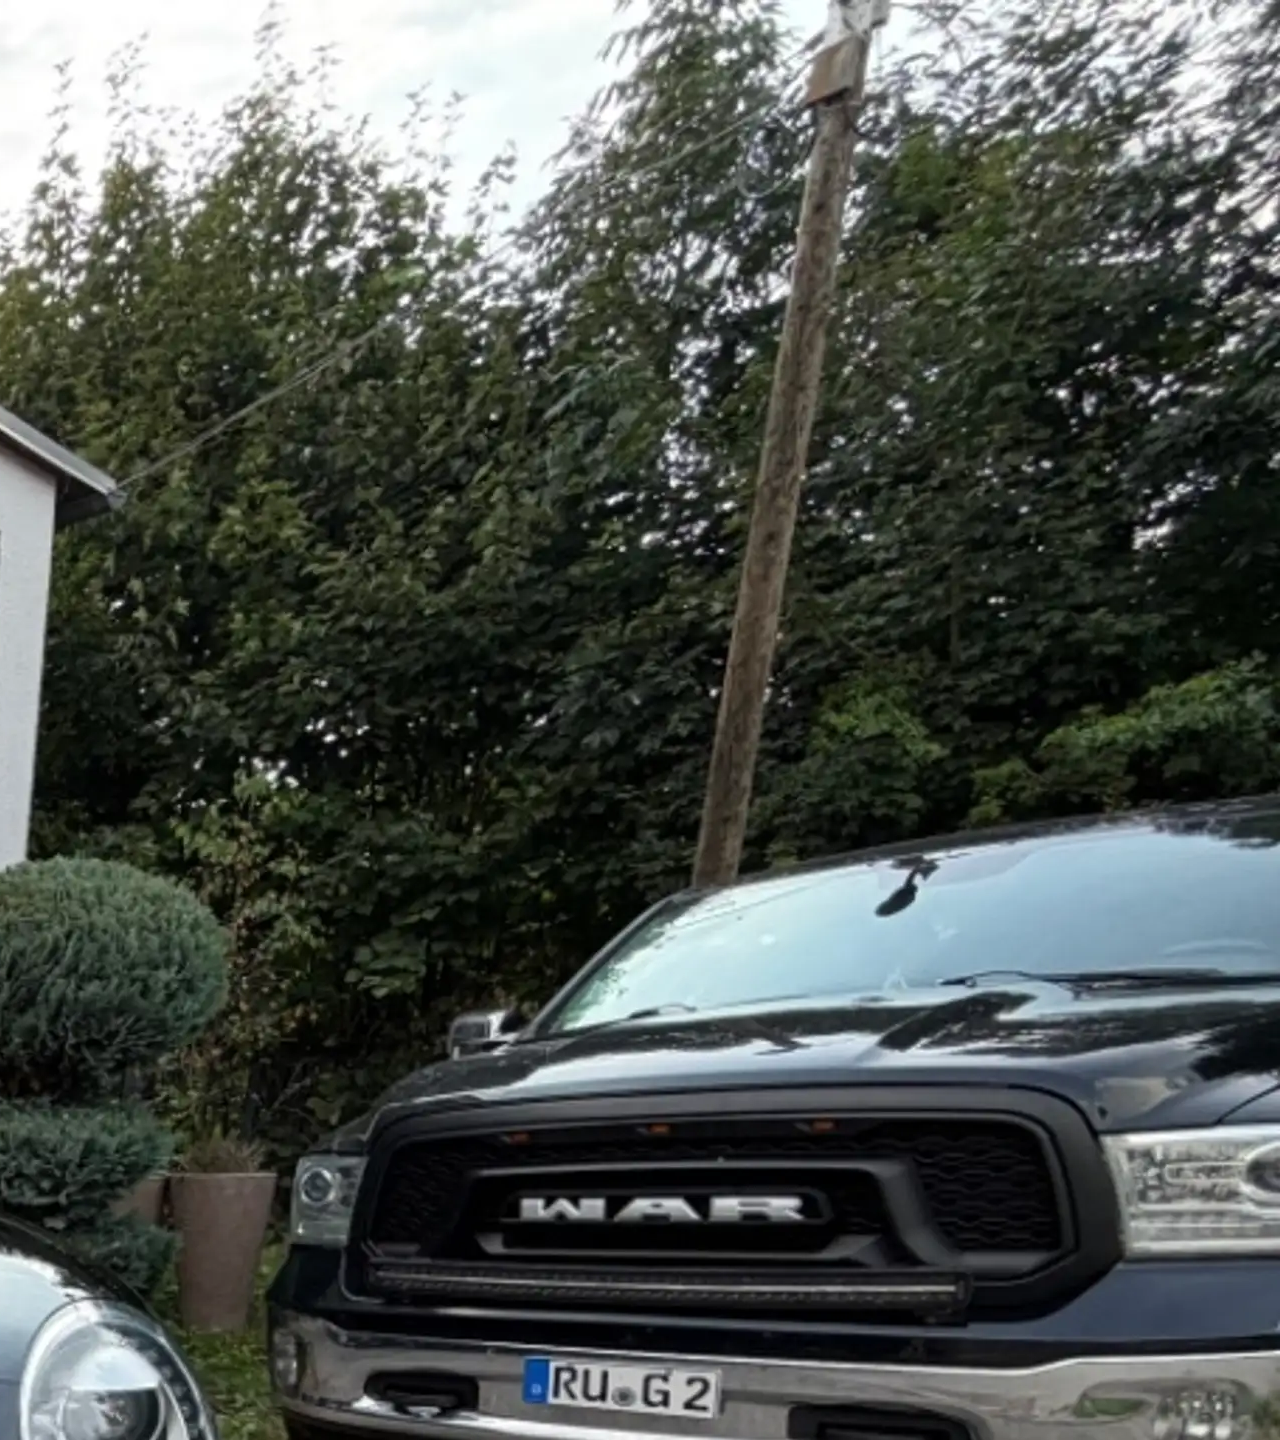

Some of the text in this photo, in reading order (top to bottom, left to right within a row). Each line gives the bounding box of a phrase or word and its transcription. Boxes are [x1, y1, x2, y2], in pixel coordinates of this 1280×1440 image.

[520, 1197, 804, 1222] WAR
[553, 1366, 609, 1402] RU
[643, 1372, 670, 1408] G
[683, 1377, 711, 1411] 2
